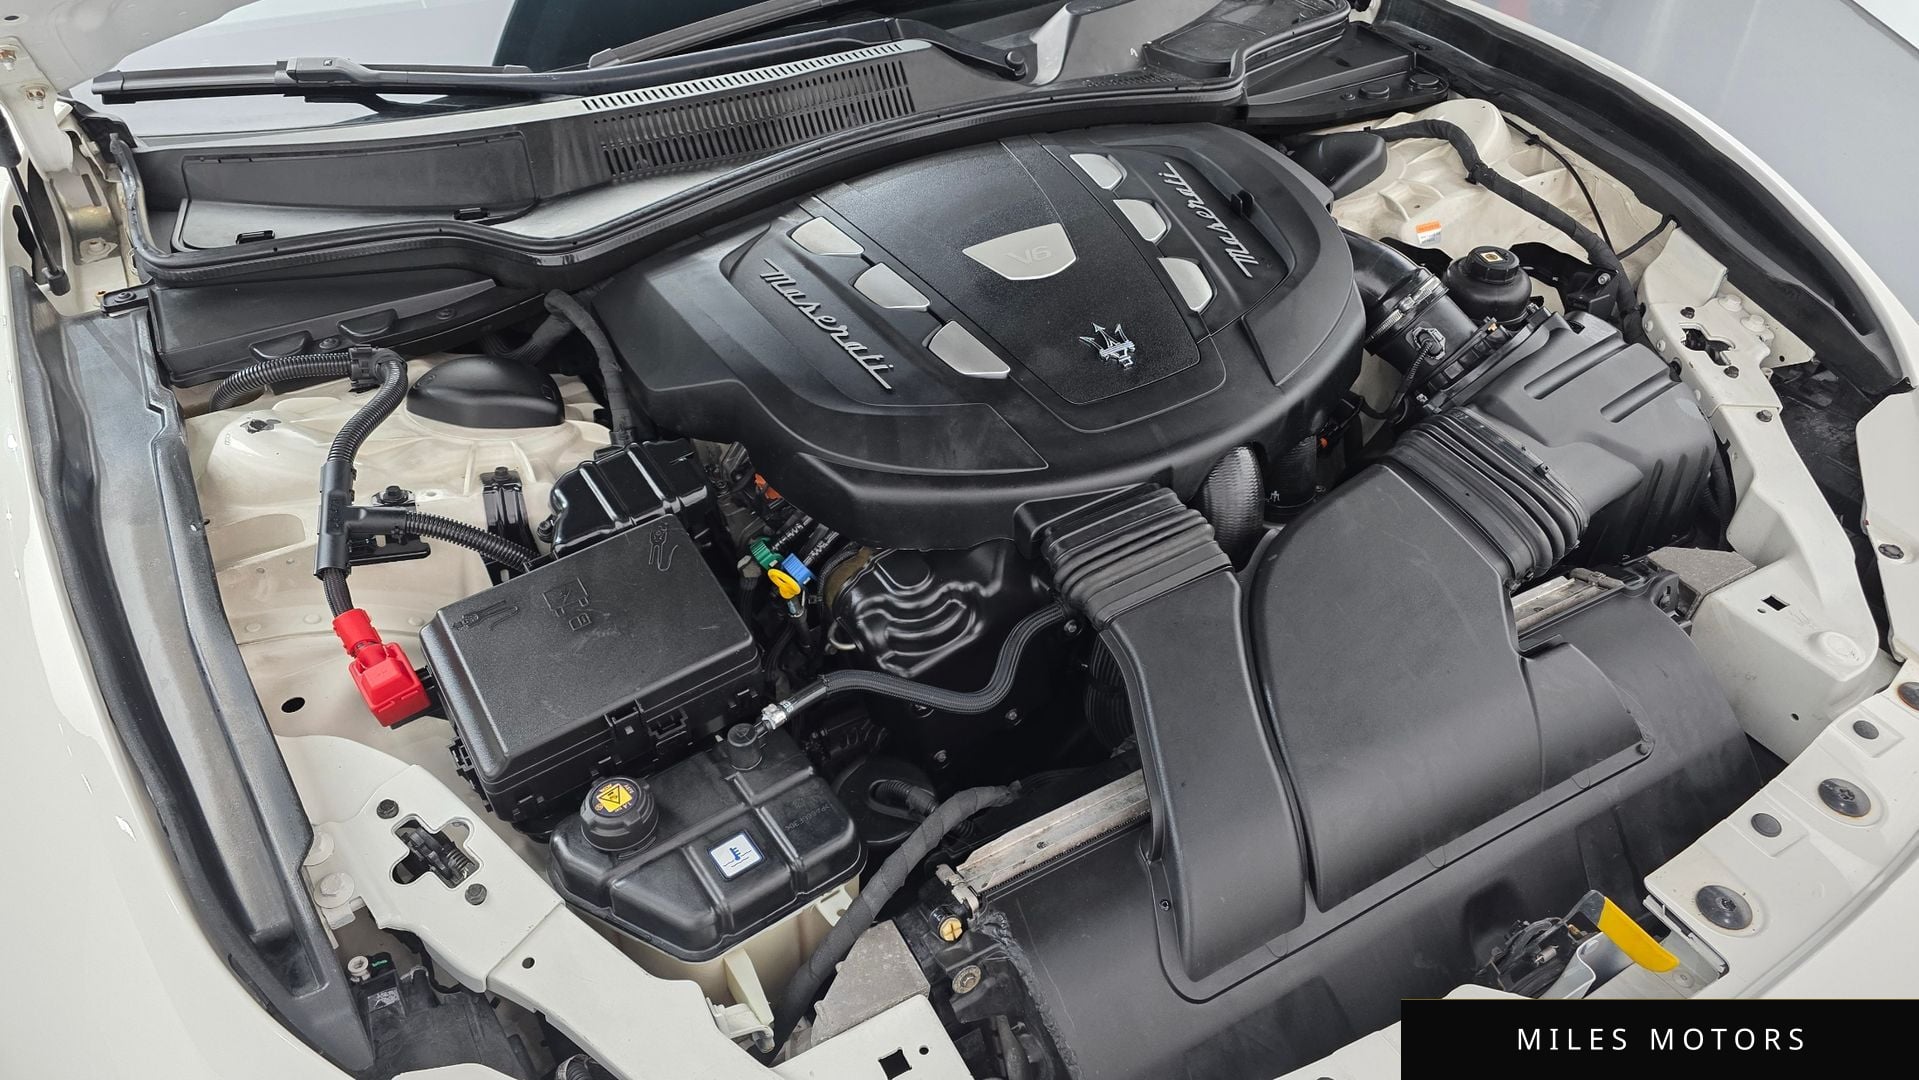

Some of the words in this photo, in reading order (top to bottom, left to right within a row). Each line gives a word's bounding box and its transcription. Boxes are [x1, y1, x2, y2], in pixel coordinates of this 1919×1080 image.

[1003, 245, 1052, 265] V6
[1158, 161, 1259, 278] Maserati
[759, 257, 894, 390] Maserati
